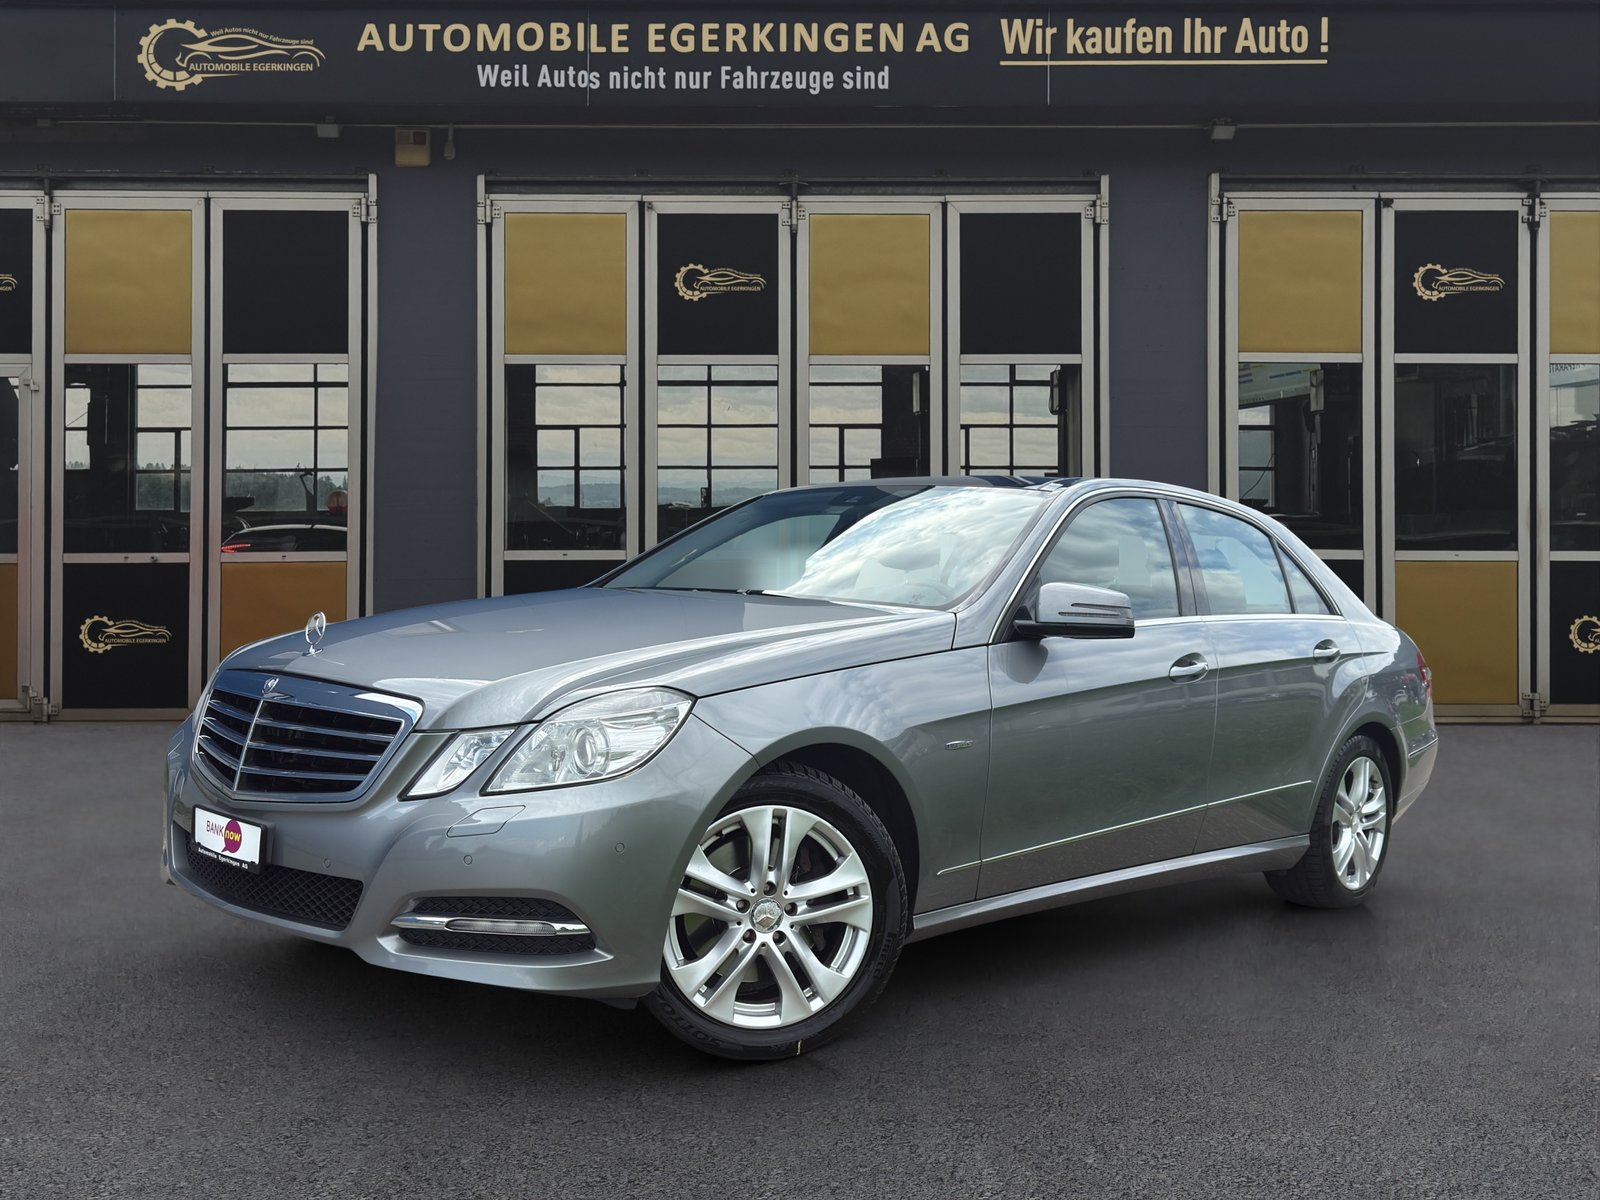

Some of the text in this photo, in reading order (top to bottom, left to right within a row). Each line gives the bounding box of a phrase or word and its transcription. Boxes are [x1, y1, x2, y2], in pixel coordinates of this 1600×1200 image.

[210, 29, 224, 37] Weil
[242, 28, 259, 36] nicht
[258, 32, 269, 40] nur
[269, 35, 300, 45] Fahrzeuge
[356, 21, 970, 53] AUTOMOBILE EGERKINGEN AG
[1000, 18, 1057, 54] Wir
[1066, 17, 1173, 54] kaufen
[1184, 17, 1228, 54] Ihr
[1234, 17, 1309, 54] Auto
[188, 62, 314, 72] AUTOMOBILE EGERKINGEN
[477, 64, 890, 95] Weil Autos nicht nur Fahrzeuge sind
[206, 820, 241, 842] BANK now
